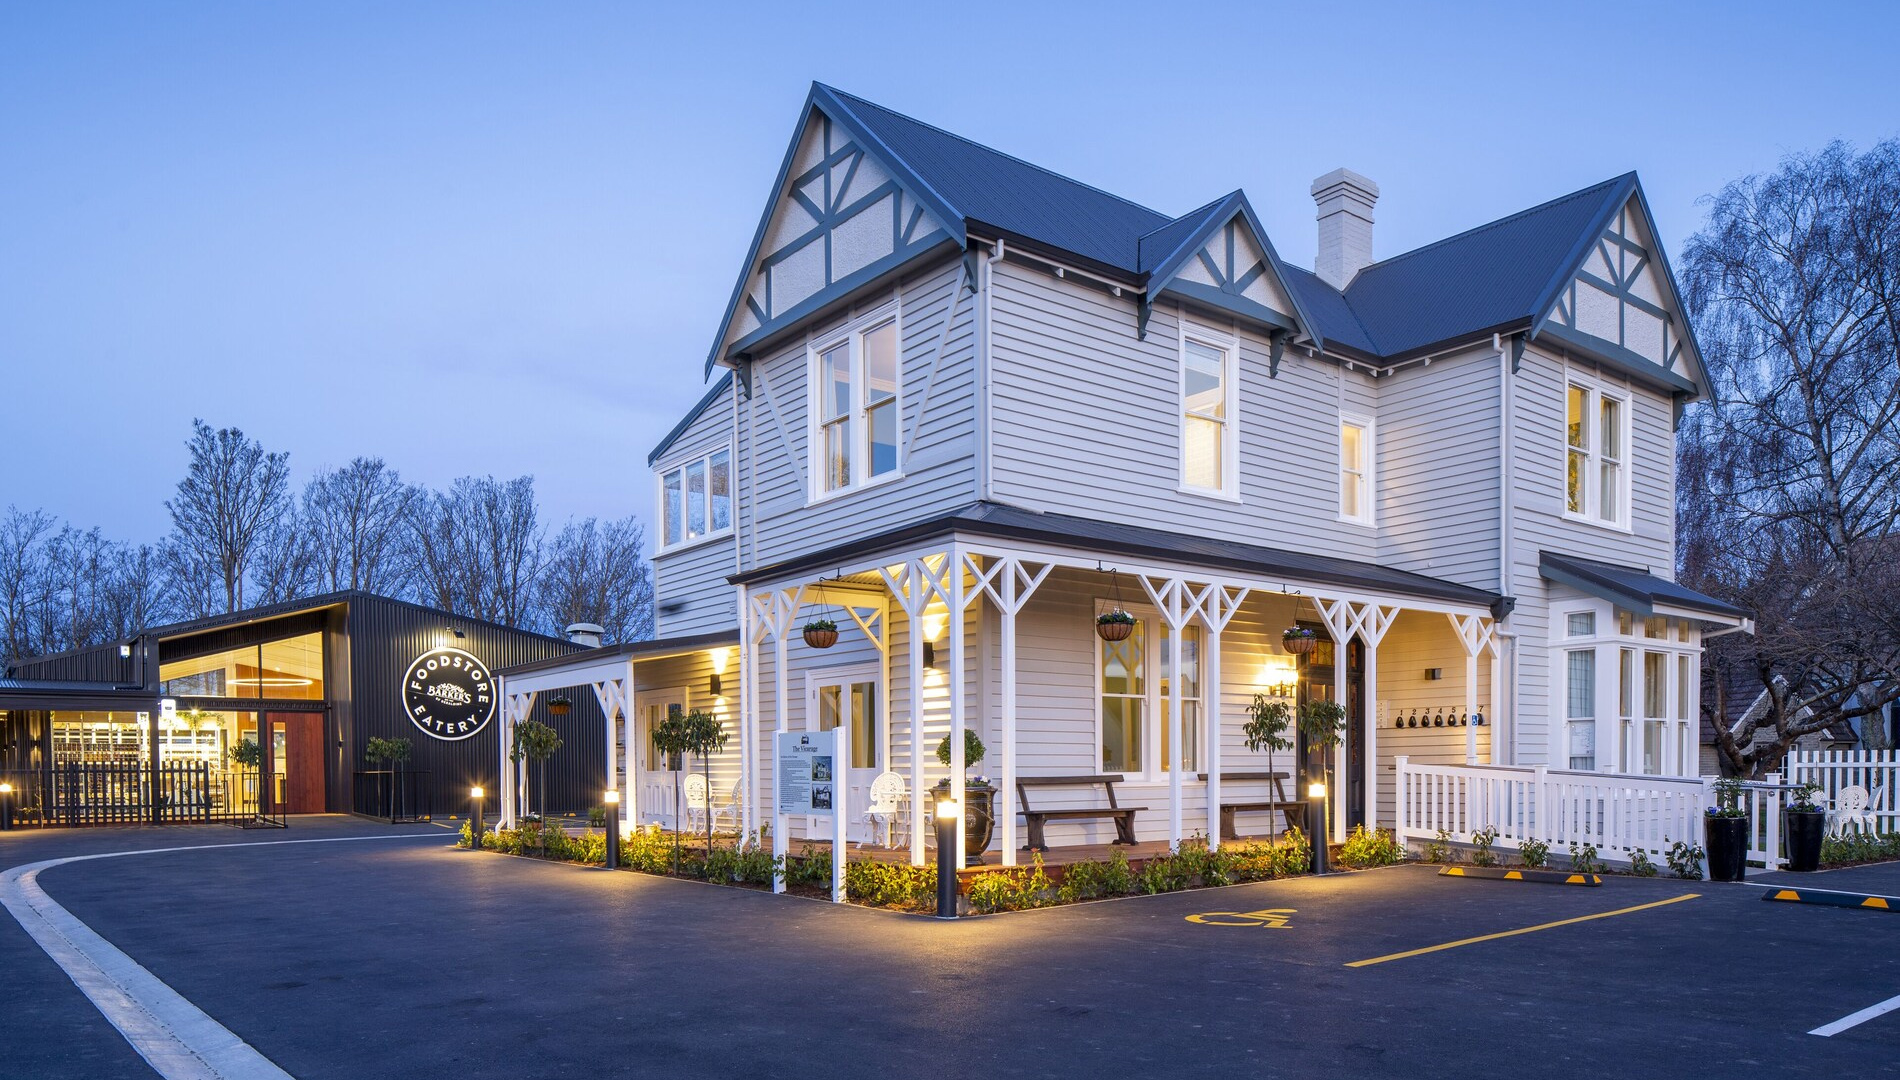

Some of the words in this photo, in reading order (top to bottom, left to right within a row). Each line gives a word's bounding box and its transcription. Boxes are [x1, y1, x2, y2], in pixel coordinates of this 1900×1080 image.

[411, 655, 489, 704] FOODSTORE
[427, 685, 471, 704] BARKER'S
[414, 705, 477, 734] EATERY
